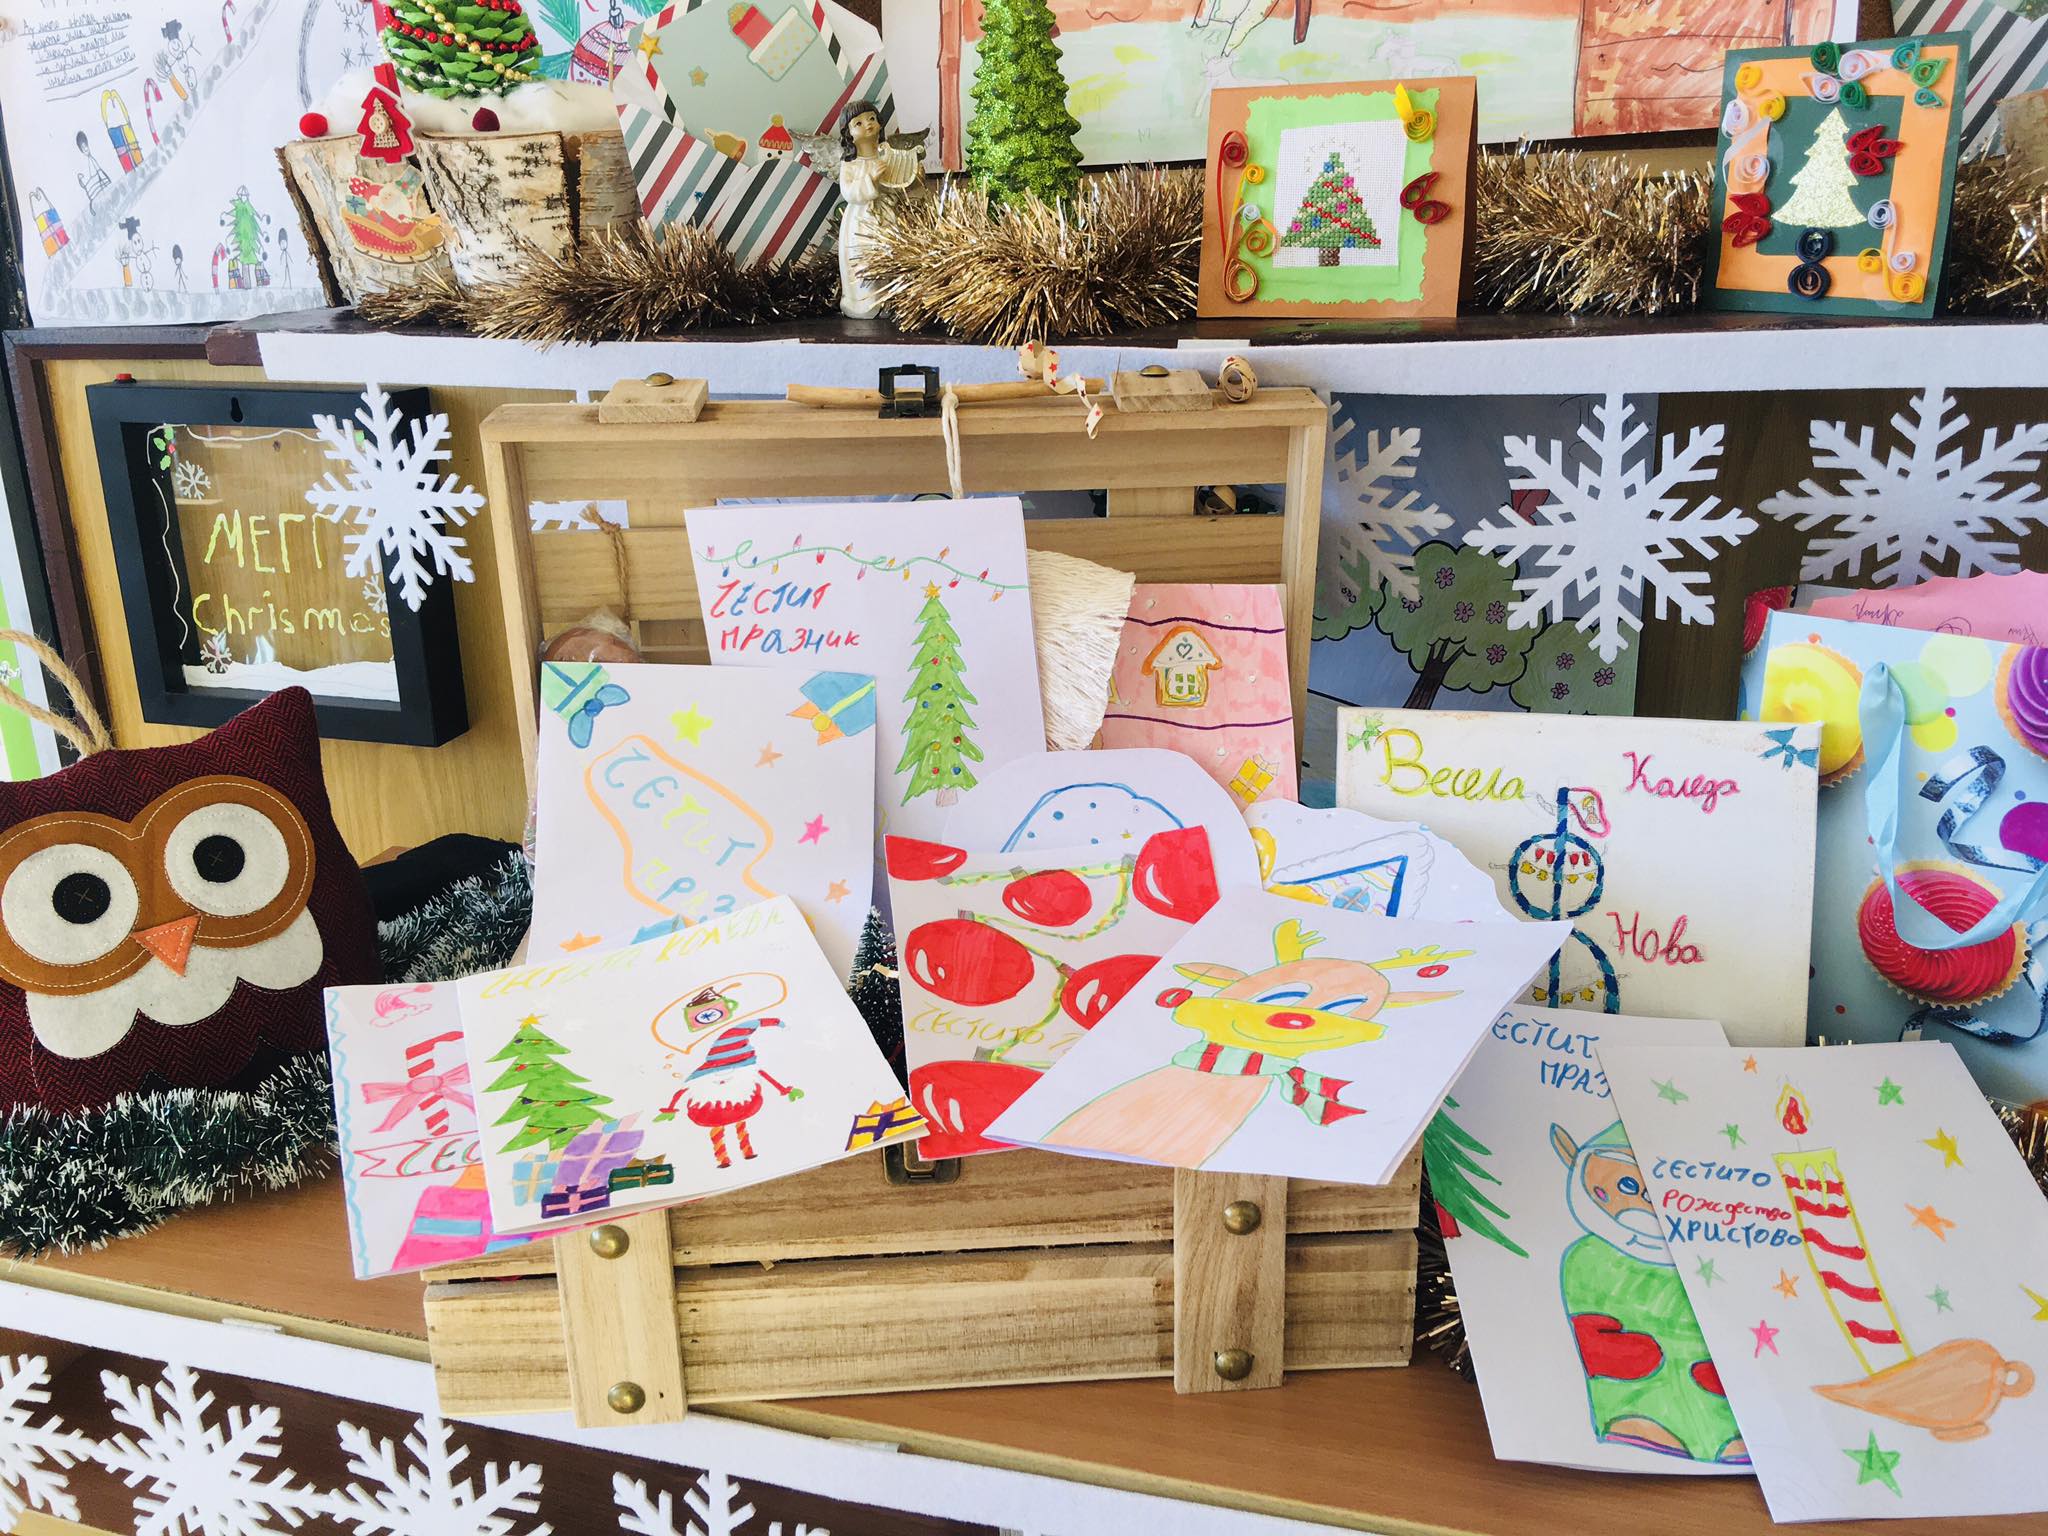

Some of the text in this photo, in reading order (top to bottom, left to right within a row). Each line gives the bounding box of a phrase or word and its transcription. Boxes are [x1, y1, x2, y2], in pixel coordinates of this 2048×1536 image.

[1606, 911, 1705, 965] Нова
[1492, 1011, 1600, 1059] ЕСТИТ
[1540, 1060, 1611, 1098] ПРАЗ
[1652, 1156, 1771, 1187] ЧЕСТИТО
